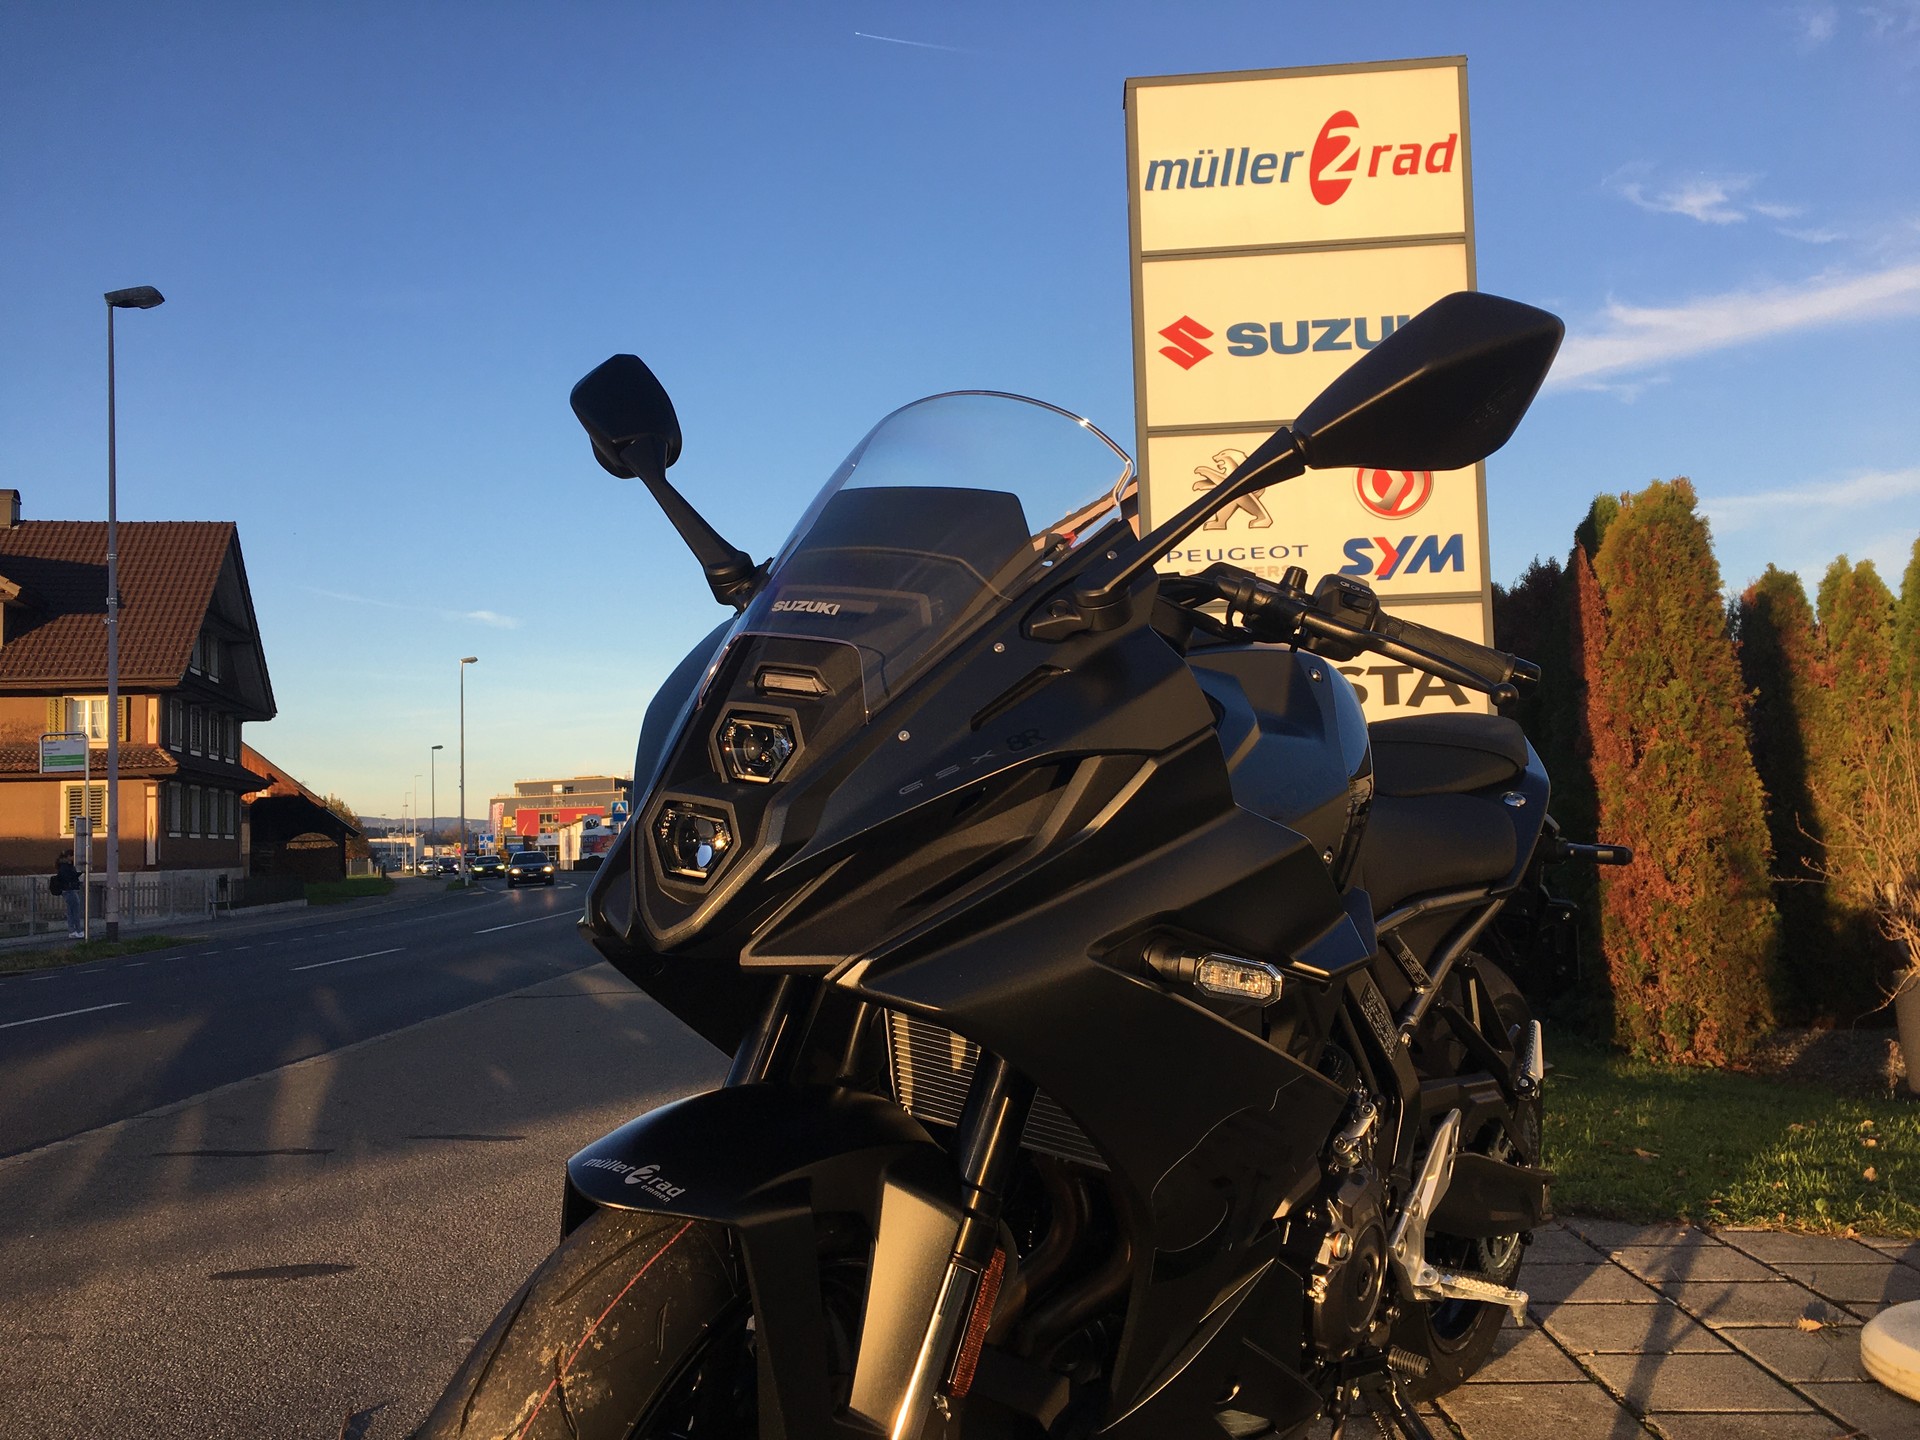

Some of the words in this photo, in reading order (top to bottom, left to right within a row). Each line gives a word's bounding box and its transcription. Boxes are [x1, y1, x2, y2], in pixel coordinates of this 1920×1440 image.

[1144, 147, 1304, 191] müller
[1367, 133, 1458, 177] rad
[1226, 314, 1410, 357] SUZU
[1165, 544, 1309, 564] PEUGEOT
[1338, 533, 1465, 580] SYM
[771, 600, 841, 616] SUZUKI
[1337, 665, 1471, 708] STA
[582, 1158, 635, 1174] müller
[647, 1177, 686, 1198] rad
[640, 1184, 671, 1203] emmen
